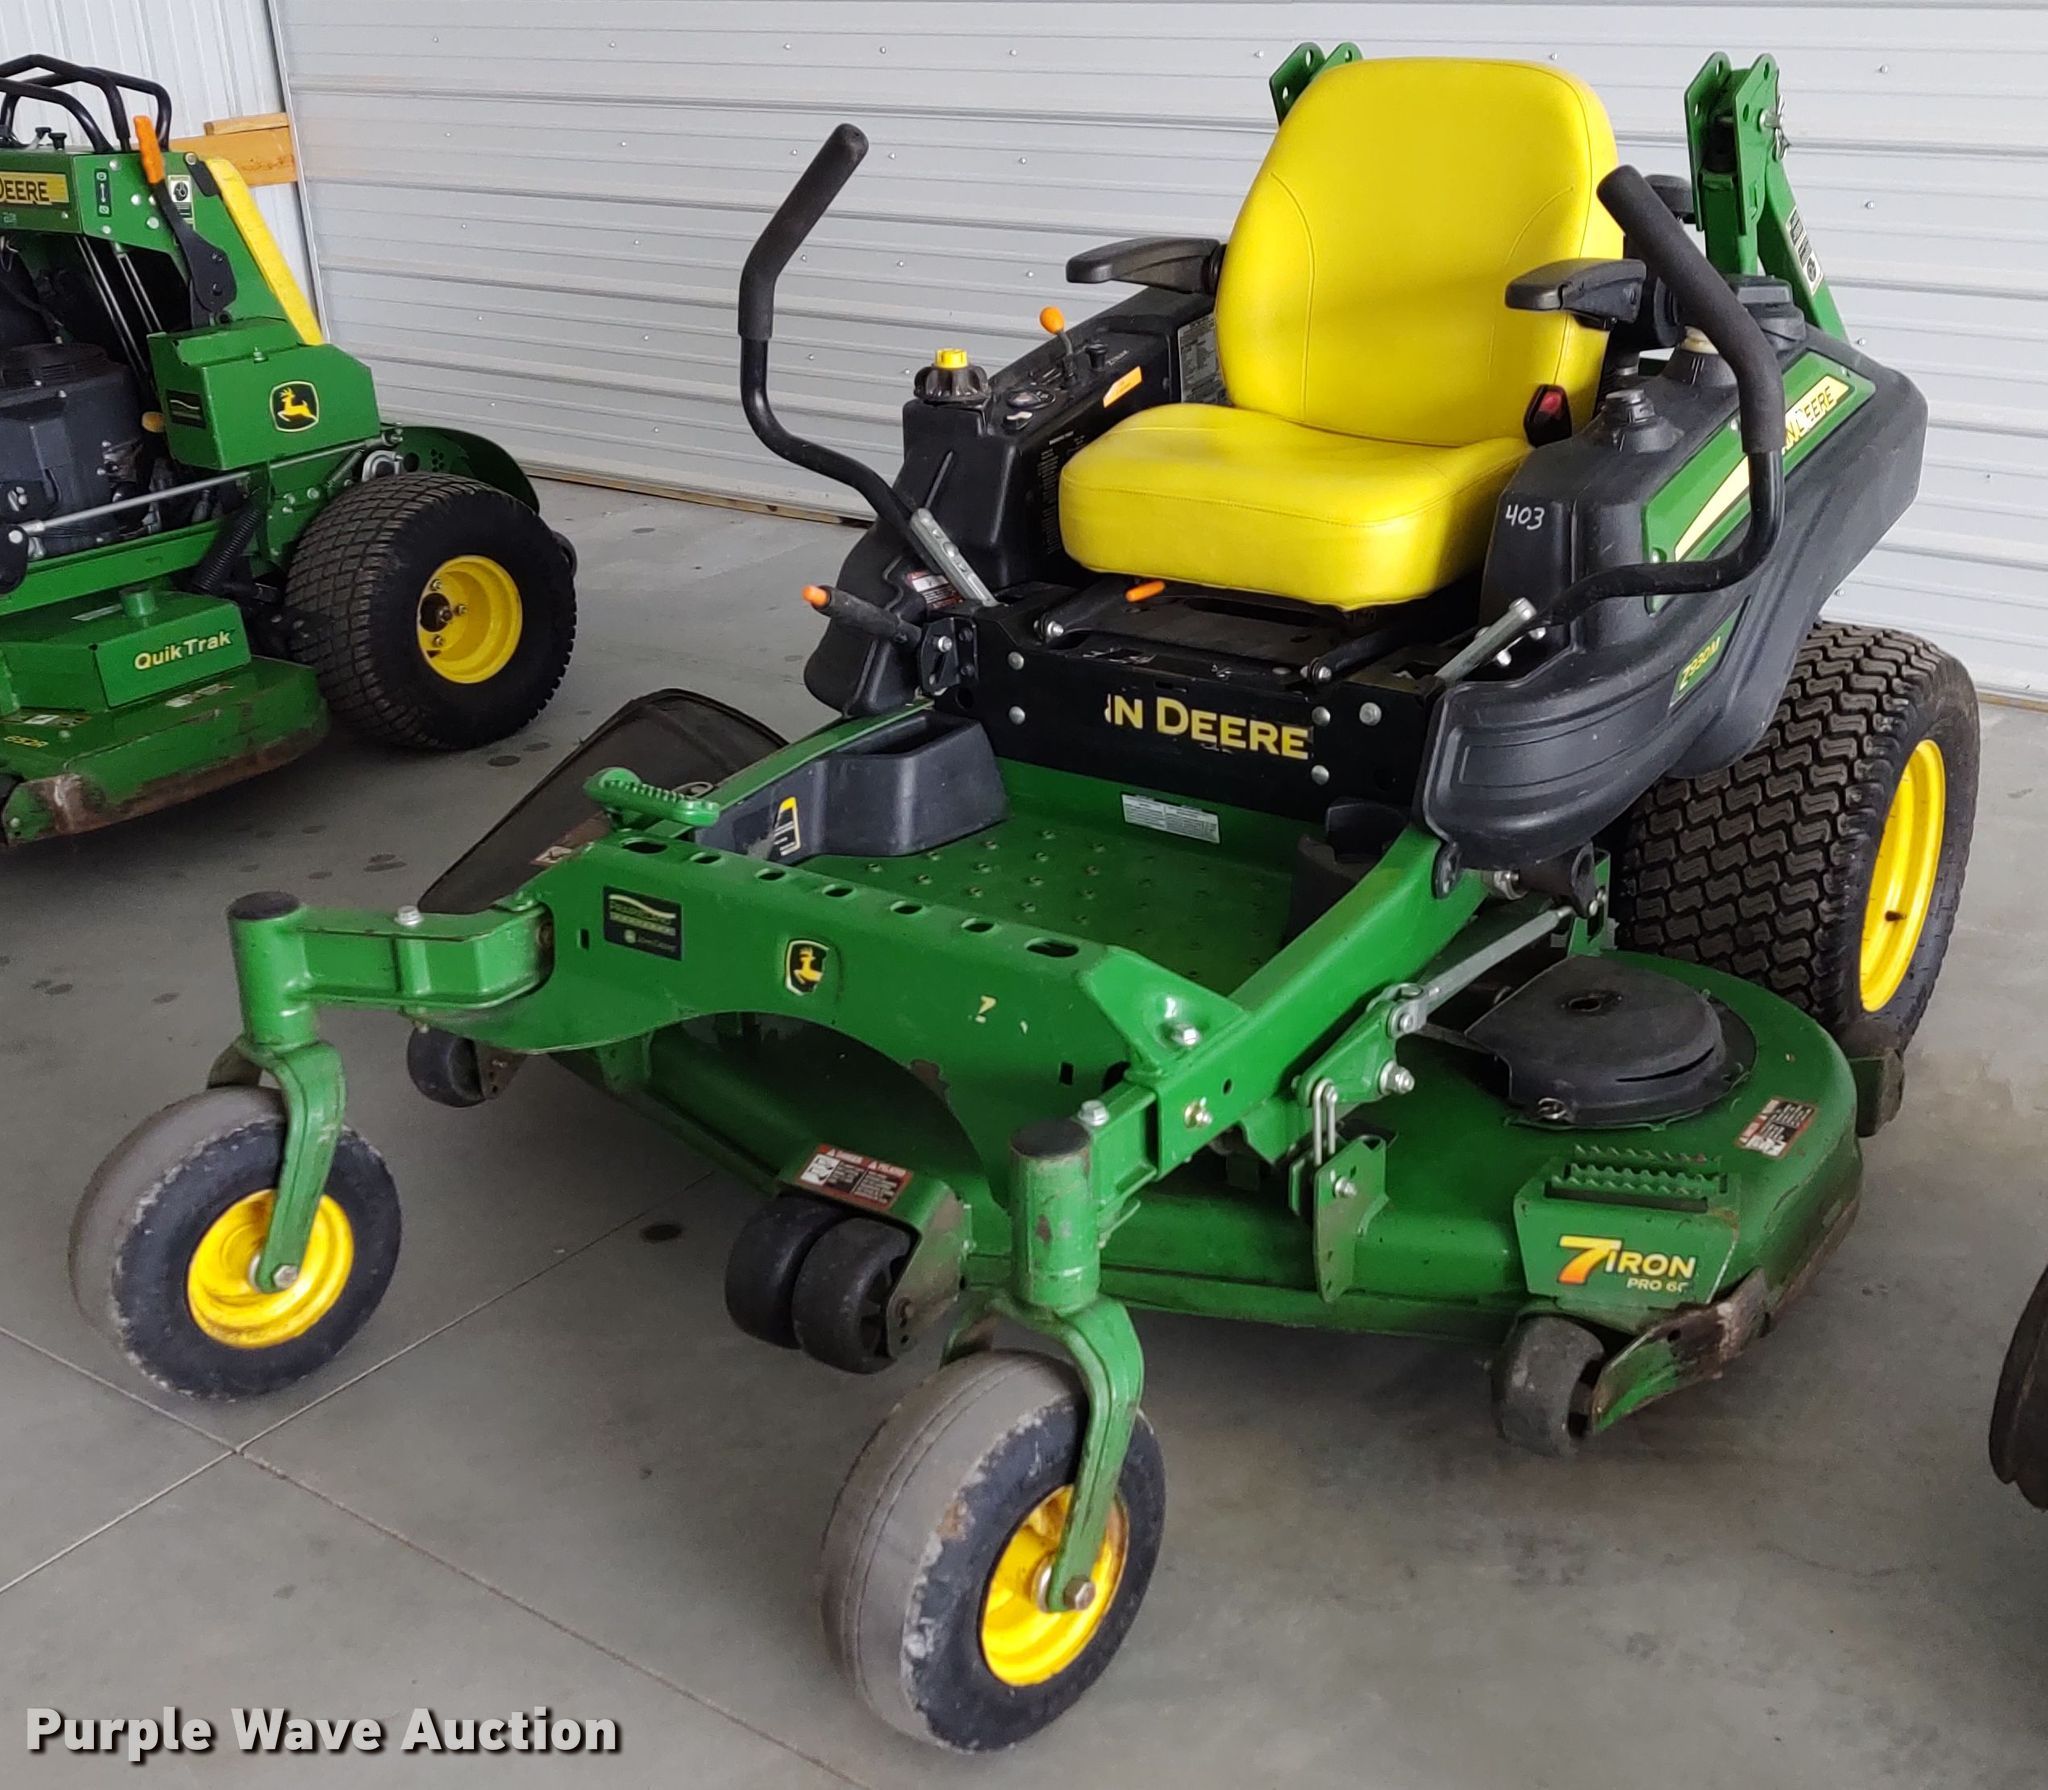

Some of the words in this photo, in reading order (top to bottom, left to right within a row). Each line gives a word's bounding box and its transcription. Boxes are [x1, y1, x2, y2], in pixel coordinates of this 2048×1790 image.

[1505, 504, 1545, 530] 403
[1156, 696, 1309, 760] DEERE
[1627, 1277, 1663, 1291] PRO
